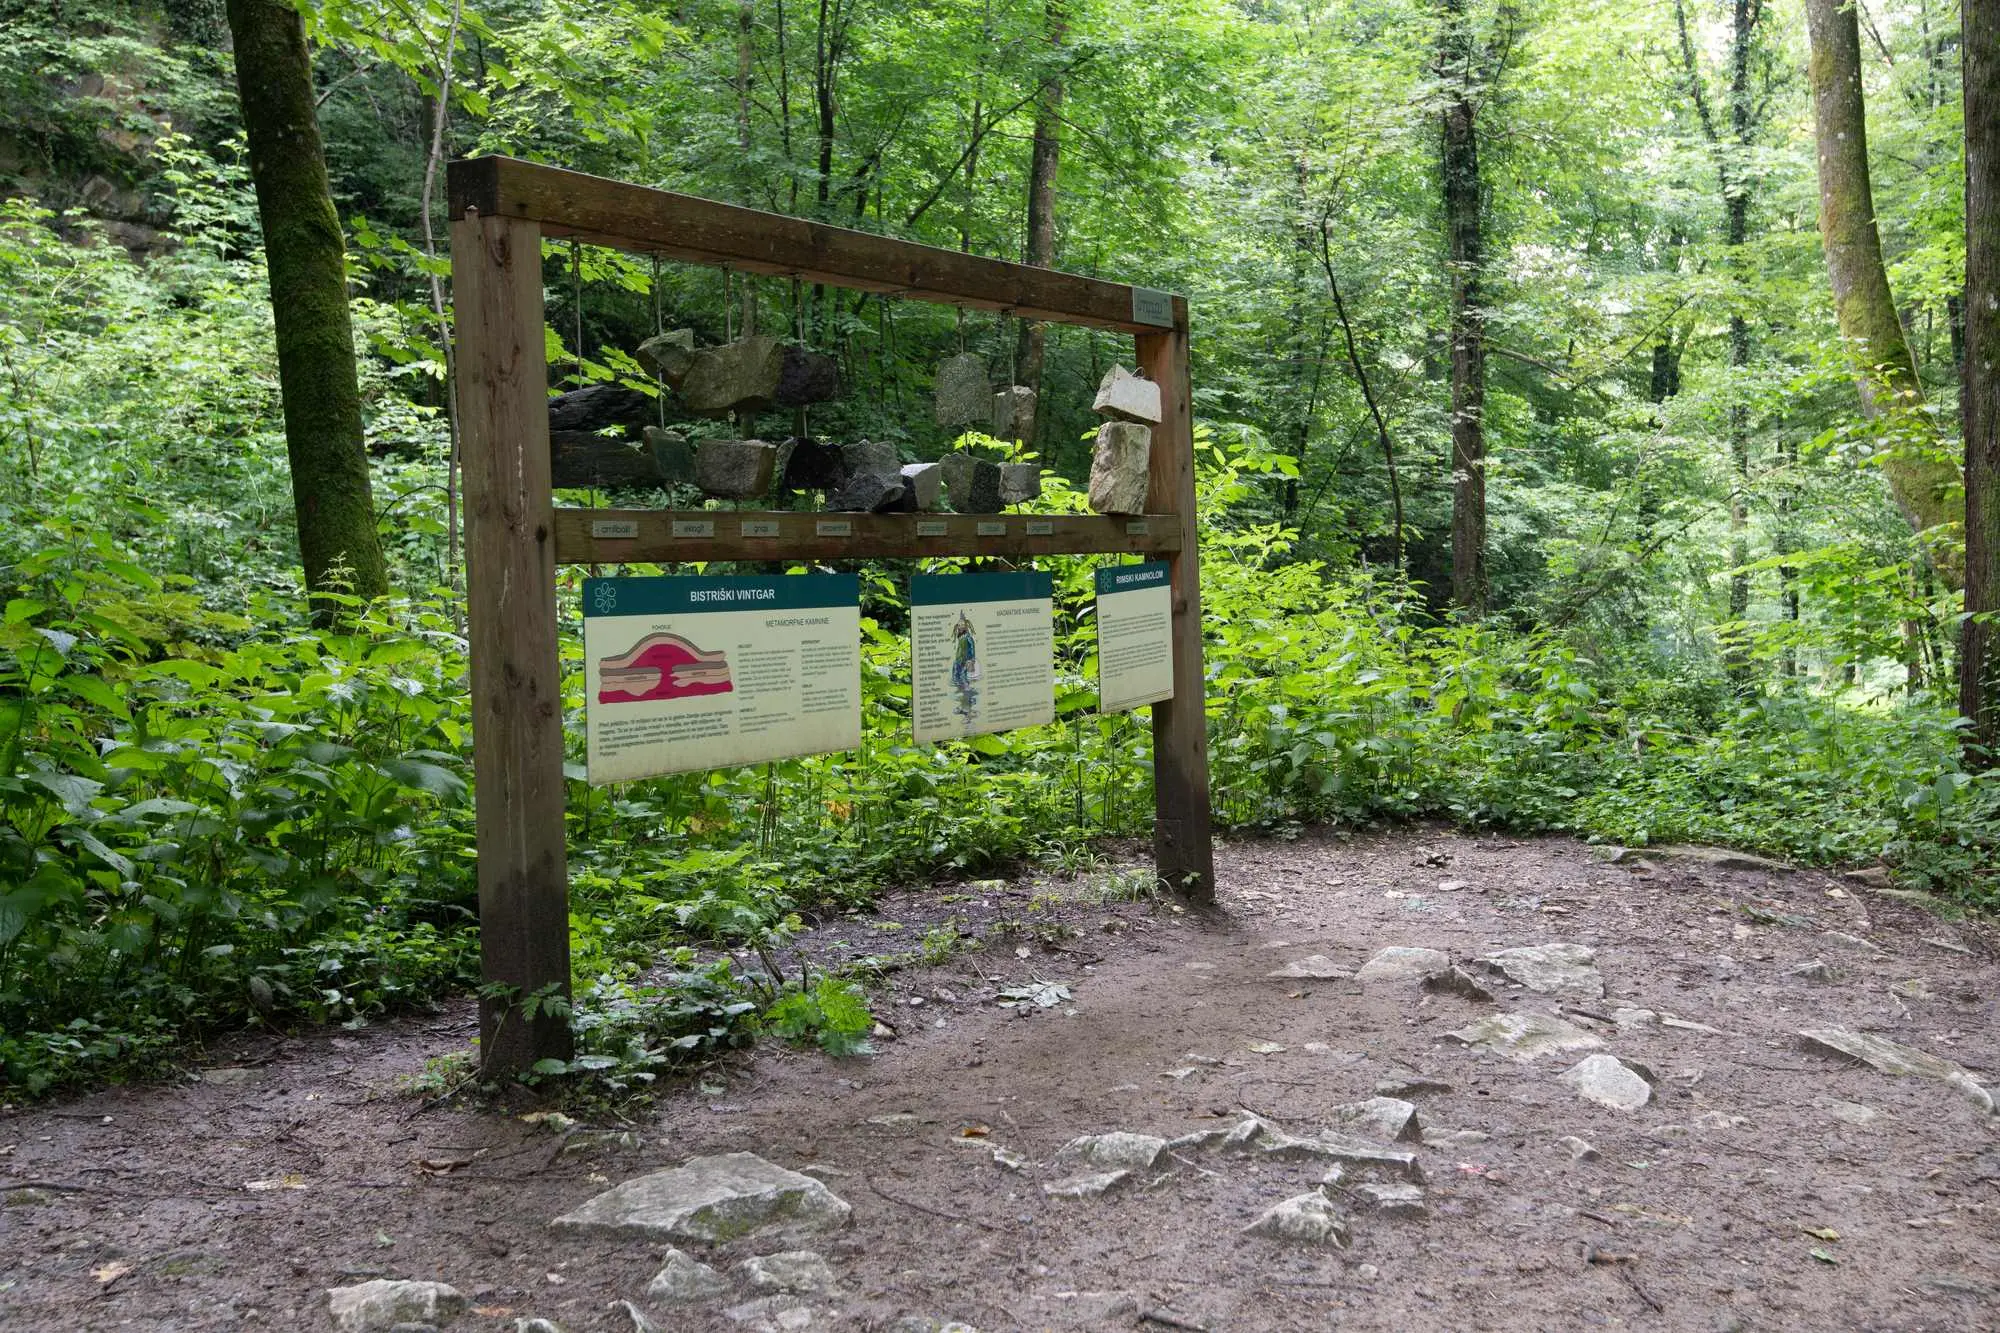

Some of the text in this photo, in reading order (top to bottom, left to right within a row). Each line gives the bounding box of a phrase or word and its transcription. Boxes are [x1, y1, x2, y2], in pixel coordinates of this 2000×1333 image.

[1116, 570, 1164, 584] RIMSKI KAMNOLOM
[690, 587, 775, 602] BISTRIŠKI VINTGAR
